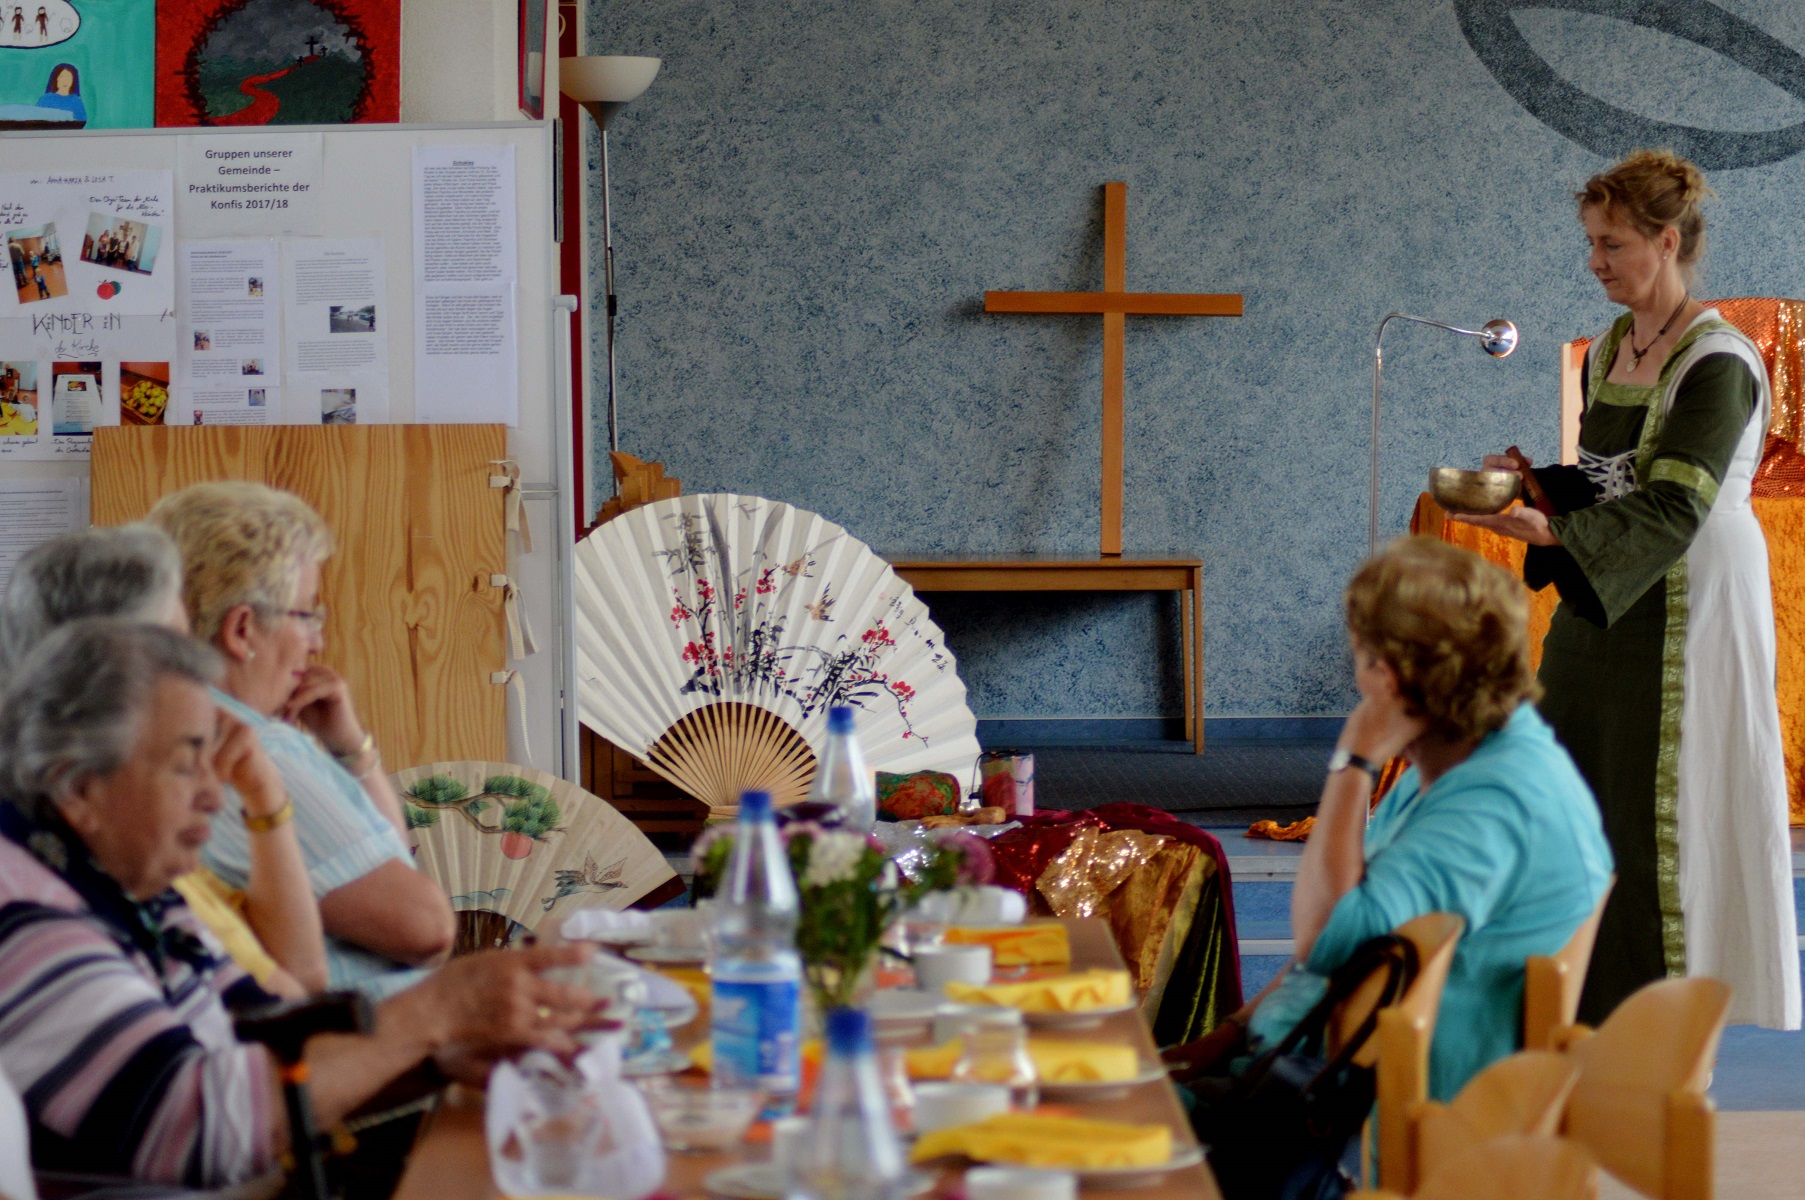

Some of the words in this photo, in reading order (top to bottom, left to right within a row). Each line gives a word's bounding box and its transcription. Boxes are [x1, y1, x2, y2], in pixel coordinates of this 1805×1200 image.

[205, 149, 250, 160] Gruppen
[253, 150, 293, 158] unserer
[218, 165, 271, 175] Gemeinde
[189, 183, 290, 194] Praktikumsberichte
[292, 182, 310, 192] der
[210, 200, 243, 210] Konfis
[245, 199, 289, 210] 2017/18
